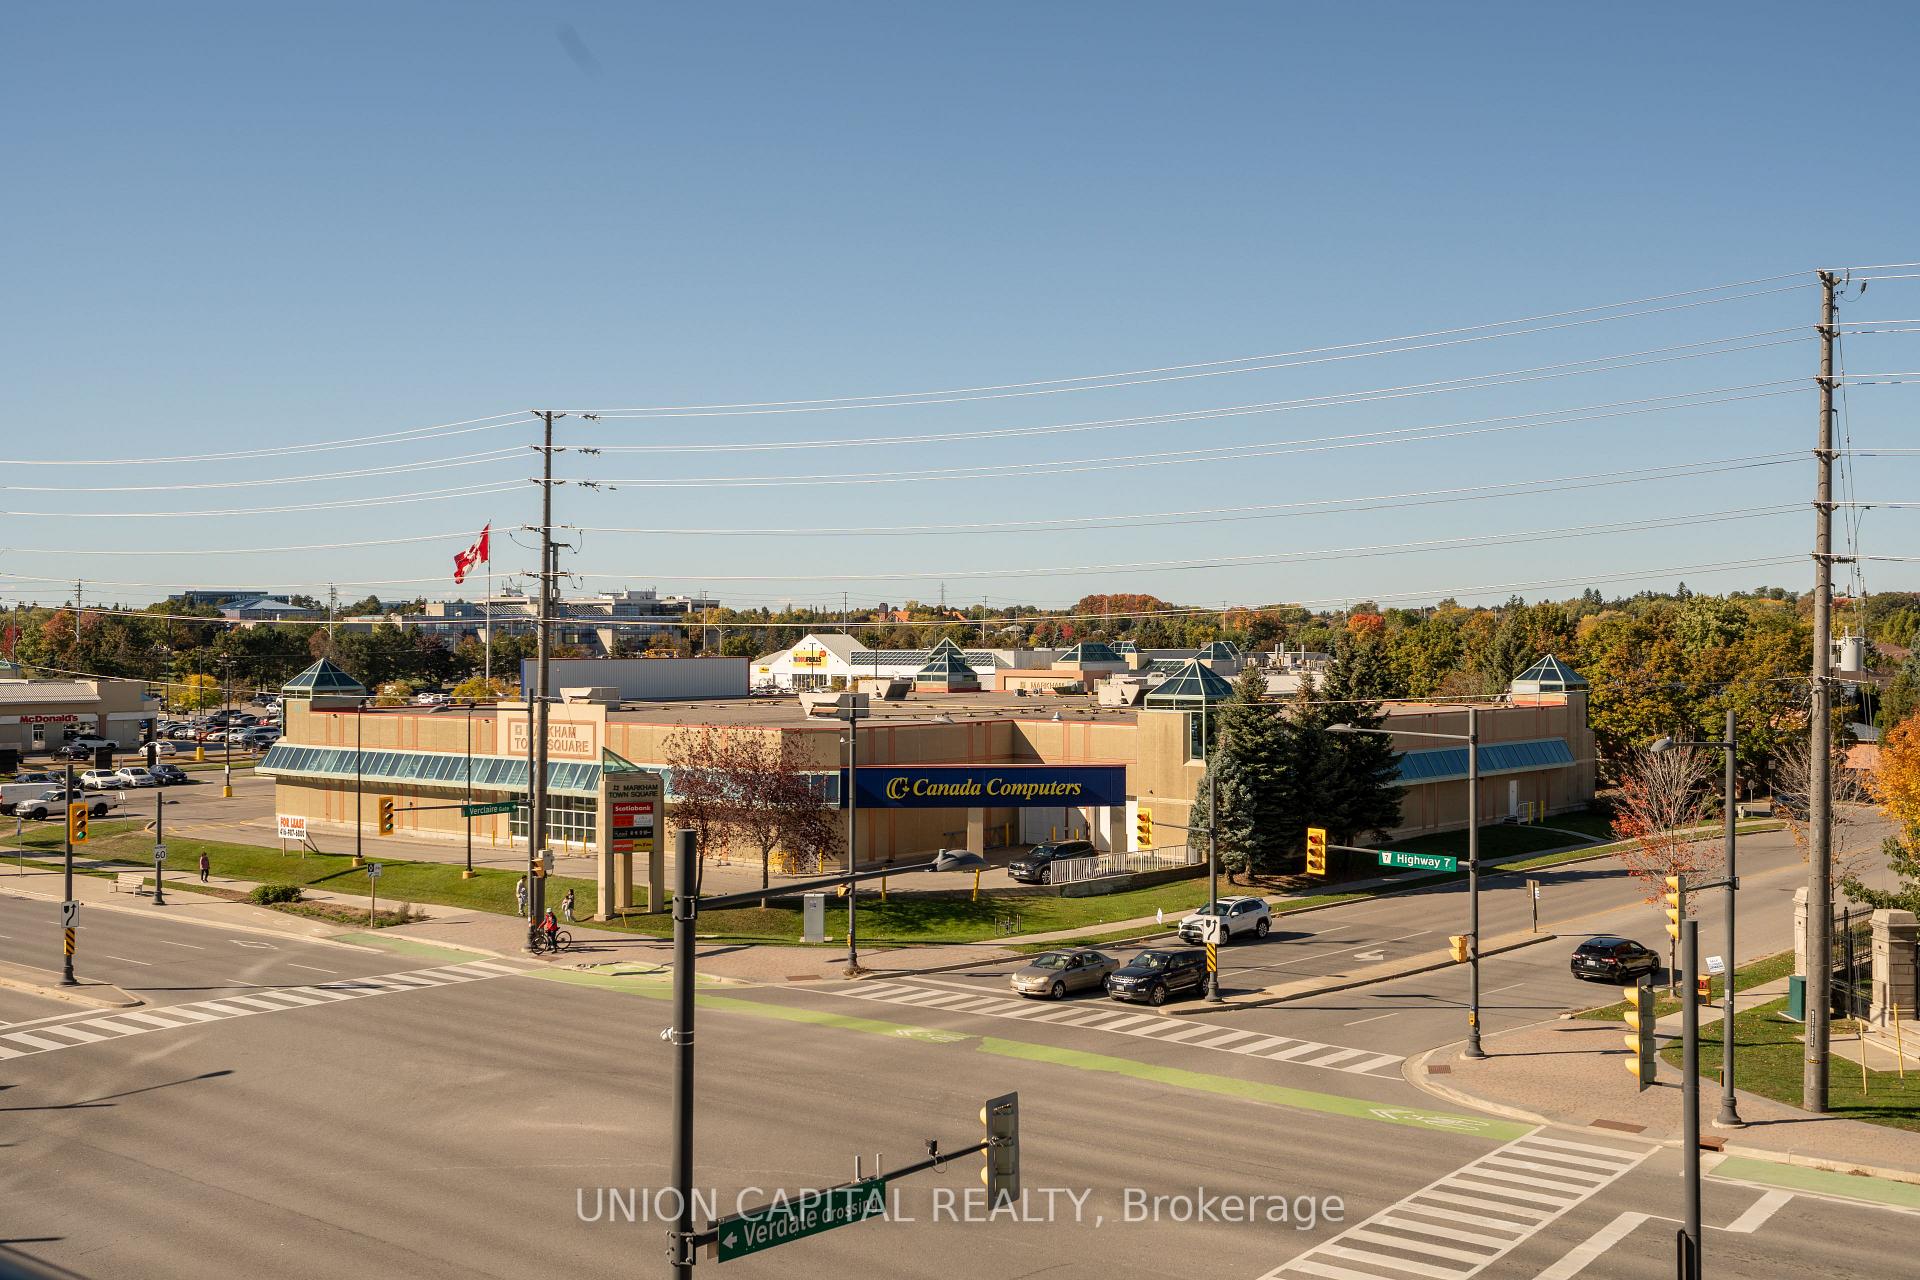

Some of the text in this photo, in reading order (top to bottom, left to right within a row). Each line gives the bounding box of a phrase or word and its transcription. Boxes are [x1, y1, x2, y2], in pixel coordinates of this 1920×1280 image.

[20, 714, 79, 723] McDonald's
[547, 739, 589, 753] SQUARE
[913, 778, 981, 797] Canada
[986, 778, 1082, 800] Computers
[470, 805, 498, 815] Verclaire
[615, 804, 651, 812] Scotiabank
[280, 817, 304, 829] FOR LEASE
[155, 850, 166, 859] 60
[1397, 853, 1440, 869] Highway
[1443, 857, 1451, 868] 7
[744, 1208, 818, 1247] Verdale
